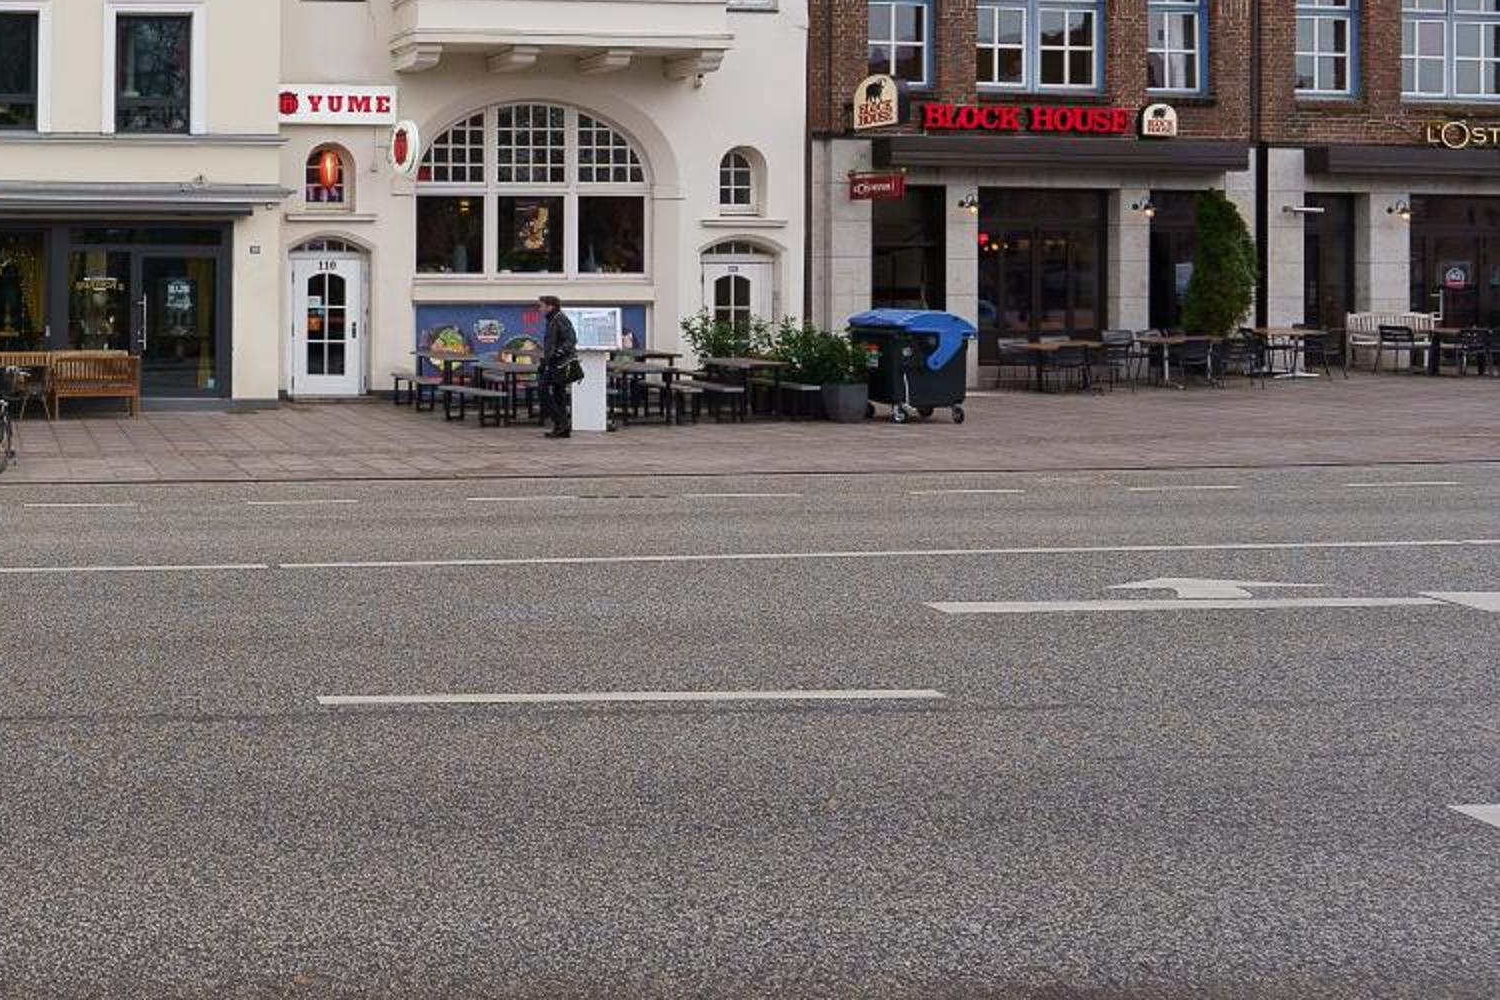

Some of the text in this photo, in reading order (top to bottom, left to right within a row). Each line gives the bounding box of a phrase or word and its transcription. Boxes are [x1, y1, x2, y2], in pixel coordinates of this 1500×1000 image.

[307, 95, 391, 113] YUME
[859, 100, 893, 116] BLOCK
[859, 111, 893, 126] HOUSE
[924, 104, 1128, 132] BLOCK HOUSE
[318, 261, 337, 271] 110
